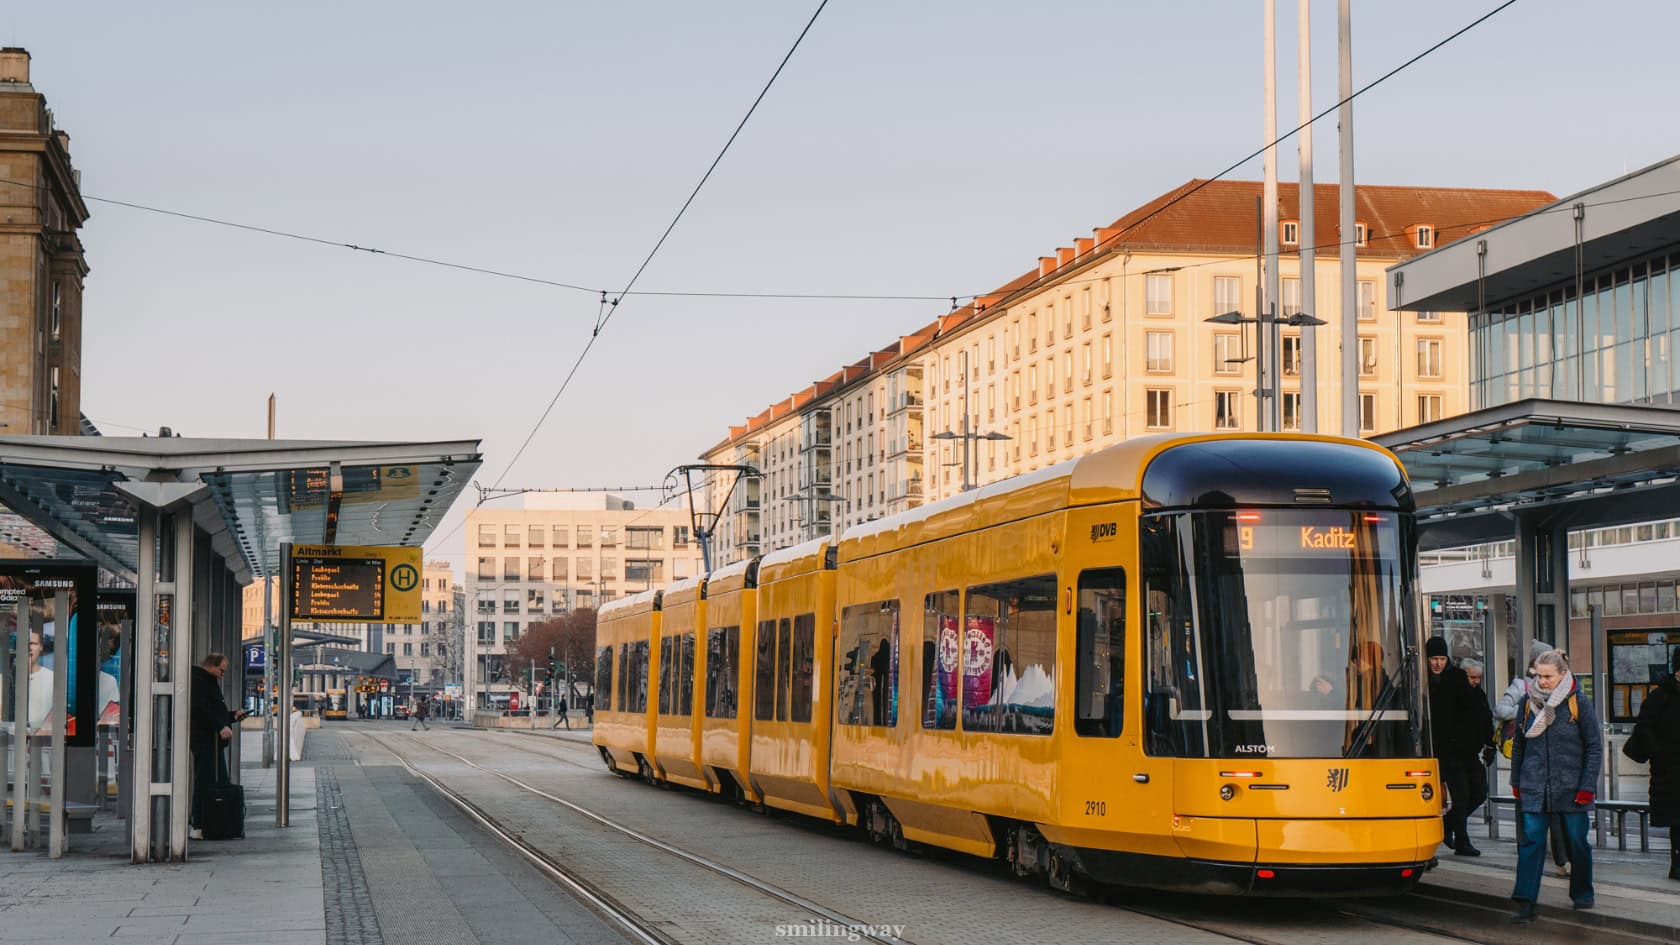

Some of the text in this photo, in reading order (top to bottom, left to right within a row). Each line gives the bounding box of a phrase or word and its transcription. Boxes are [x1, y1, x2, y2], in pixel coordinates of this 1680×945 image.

[1100, 522, 1117, 537] DVB
[1240, 527, 1355, 549] 9 Kaditz
[297, 548, 341, 556] Altmarkt
[35, 580, 74, 588] SAMSUNG
[250, 649, 259, 662] P
[1234, 744, 1276, 753] ALSTOM
[1085, 800, 1106, 816] 2910
